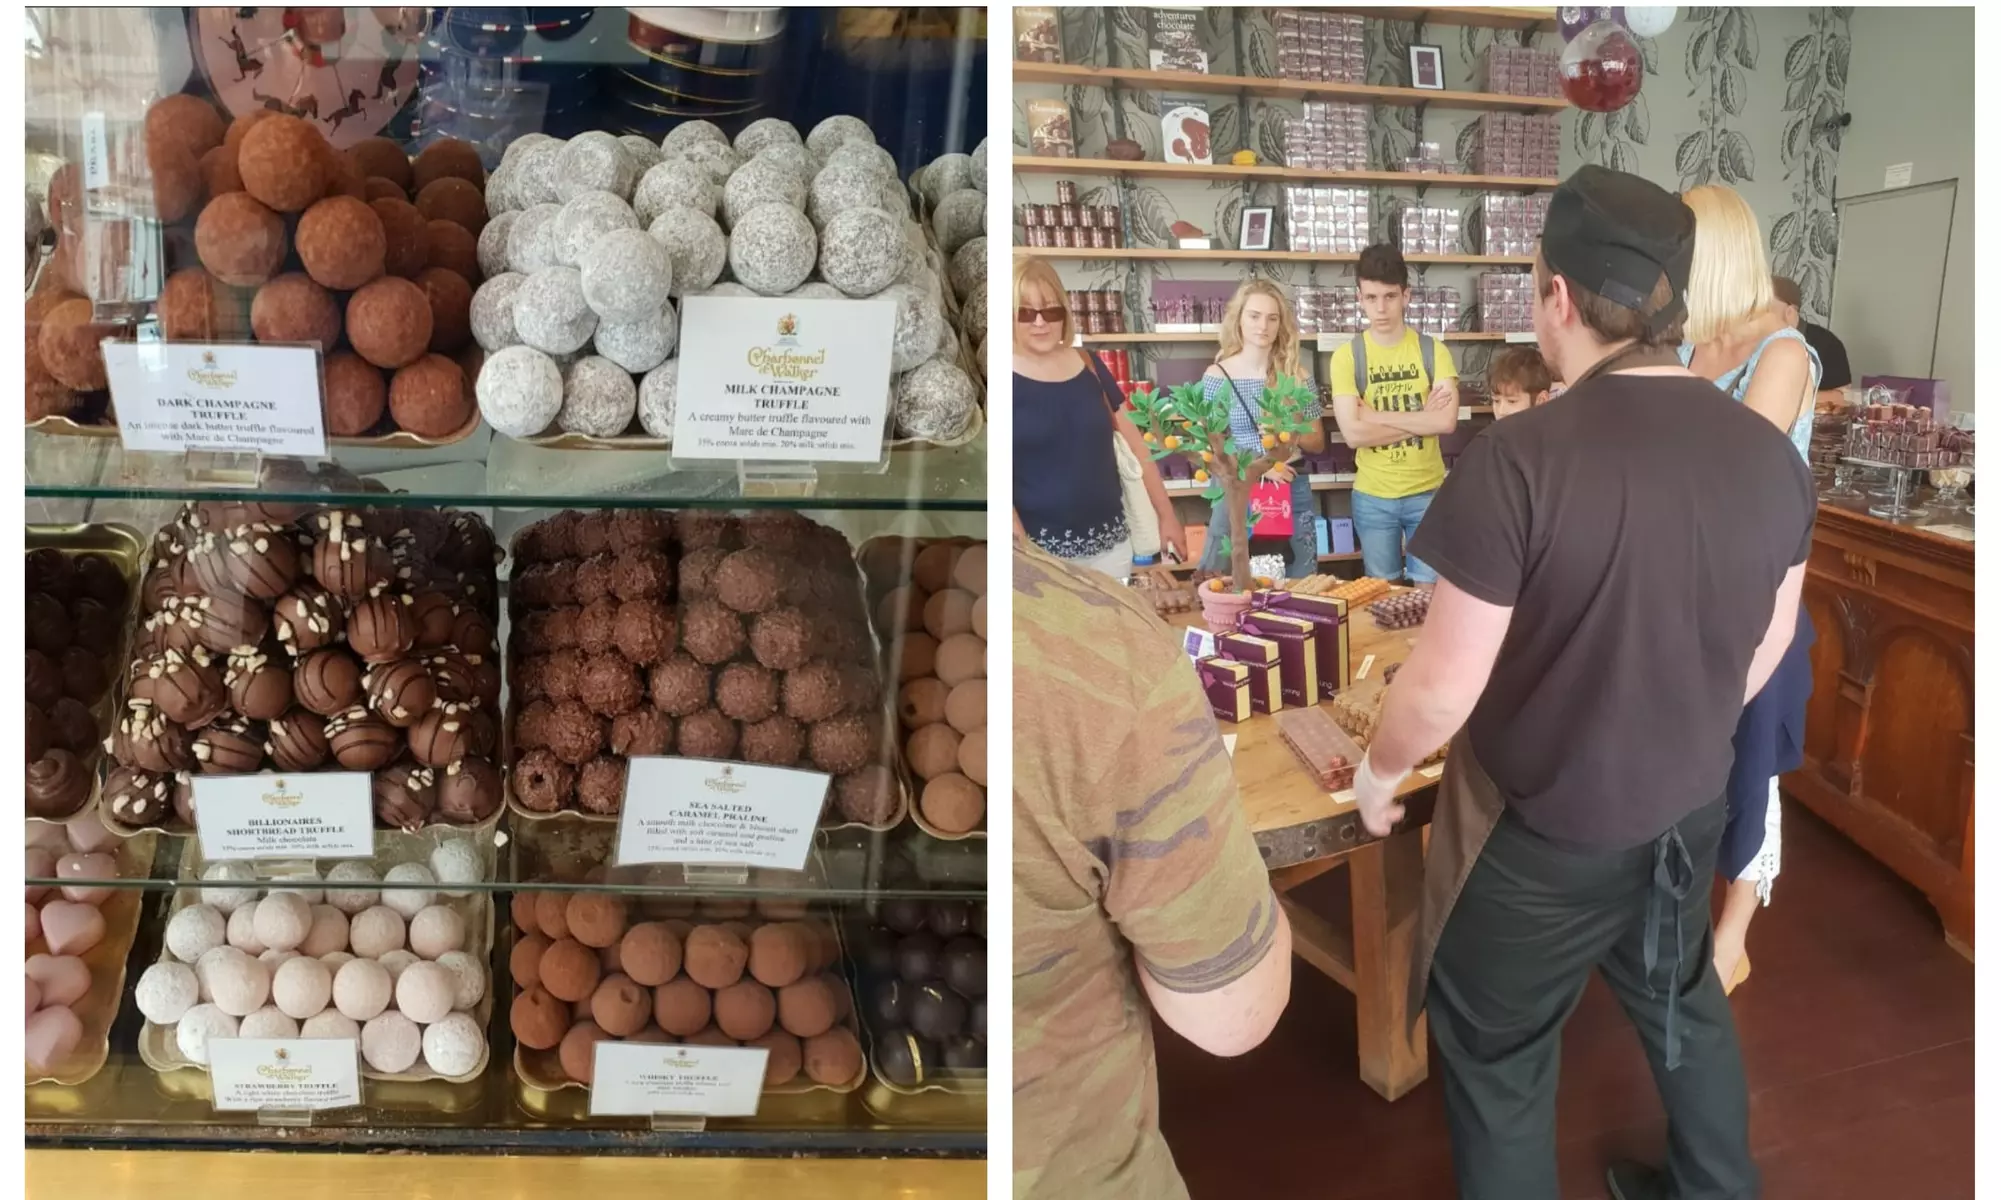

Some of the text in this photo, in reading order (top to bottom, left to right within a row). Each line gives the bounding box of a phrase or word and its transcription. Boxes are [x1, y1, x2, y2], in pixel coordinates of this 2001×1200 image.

[1369, 363, 1417, 381] TOKYO
[725, 384, 841, 397] MILK CHAMPAGNE
[157, 398, 277, 410] DARK CHAMPAGNE
[754, 398, 809, 410] TRUFFLE
[190, 410, 248, 421] TRUFFLE
[688, 412, 871, 425] A creamy butter truffle flavoured with
[127, 421, 141, 430] An
[181, 421, 202, 430] dark
[206, 422, 232, 431] butter
[236, 423, 266, 432] truffle
[270, 424, 315, 435] flavoured
[729, 426, 828, 439] Marc de Champagne
[161, 432, 284, 445] with Marc de Champagne
[689, 801, 752, 813] SEA SALTED
[248, 817, 323, 827] BILLIONAIRES
[669, 810, 768, 823] CARAMEL PRALINE
[226, 826, 345, 836] SHORTBREAD TRUFFLE
[257, 836, 277, 844] Milk
